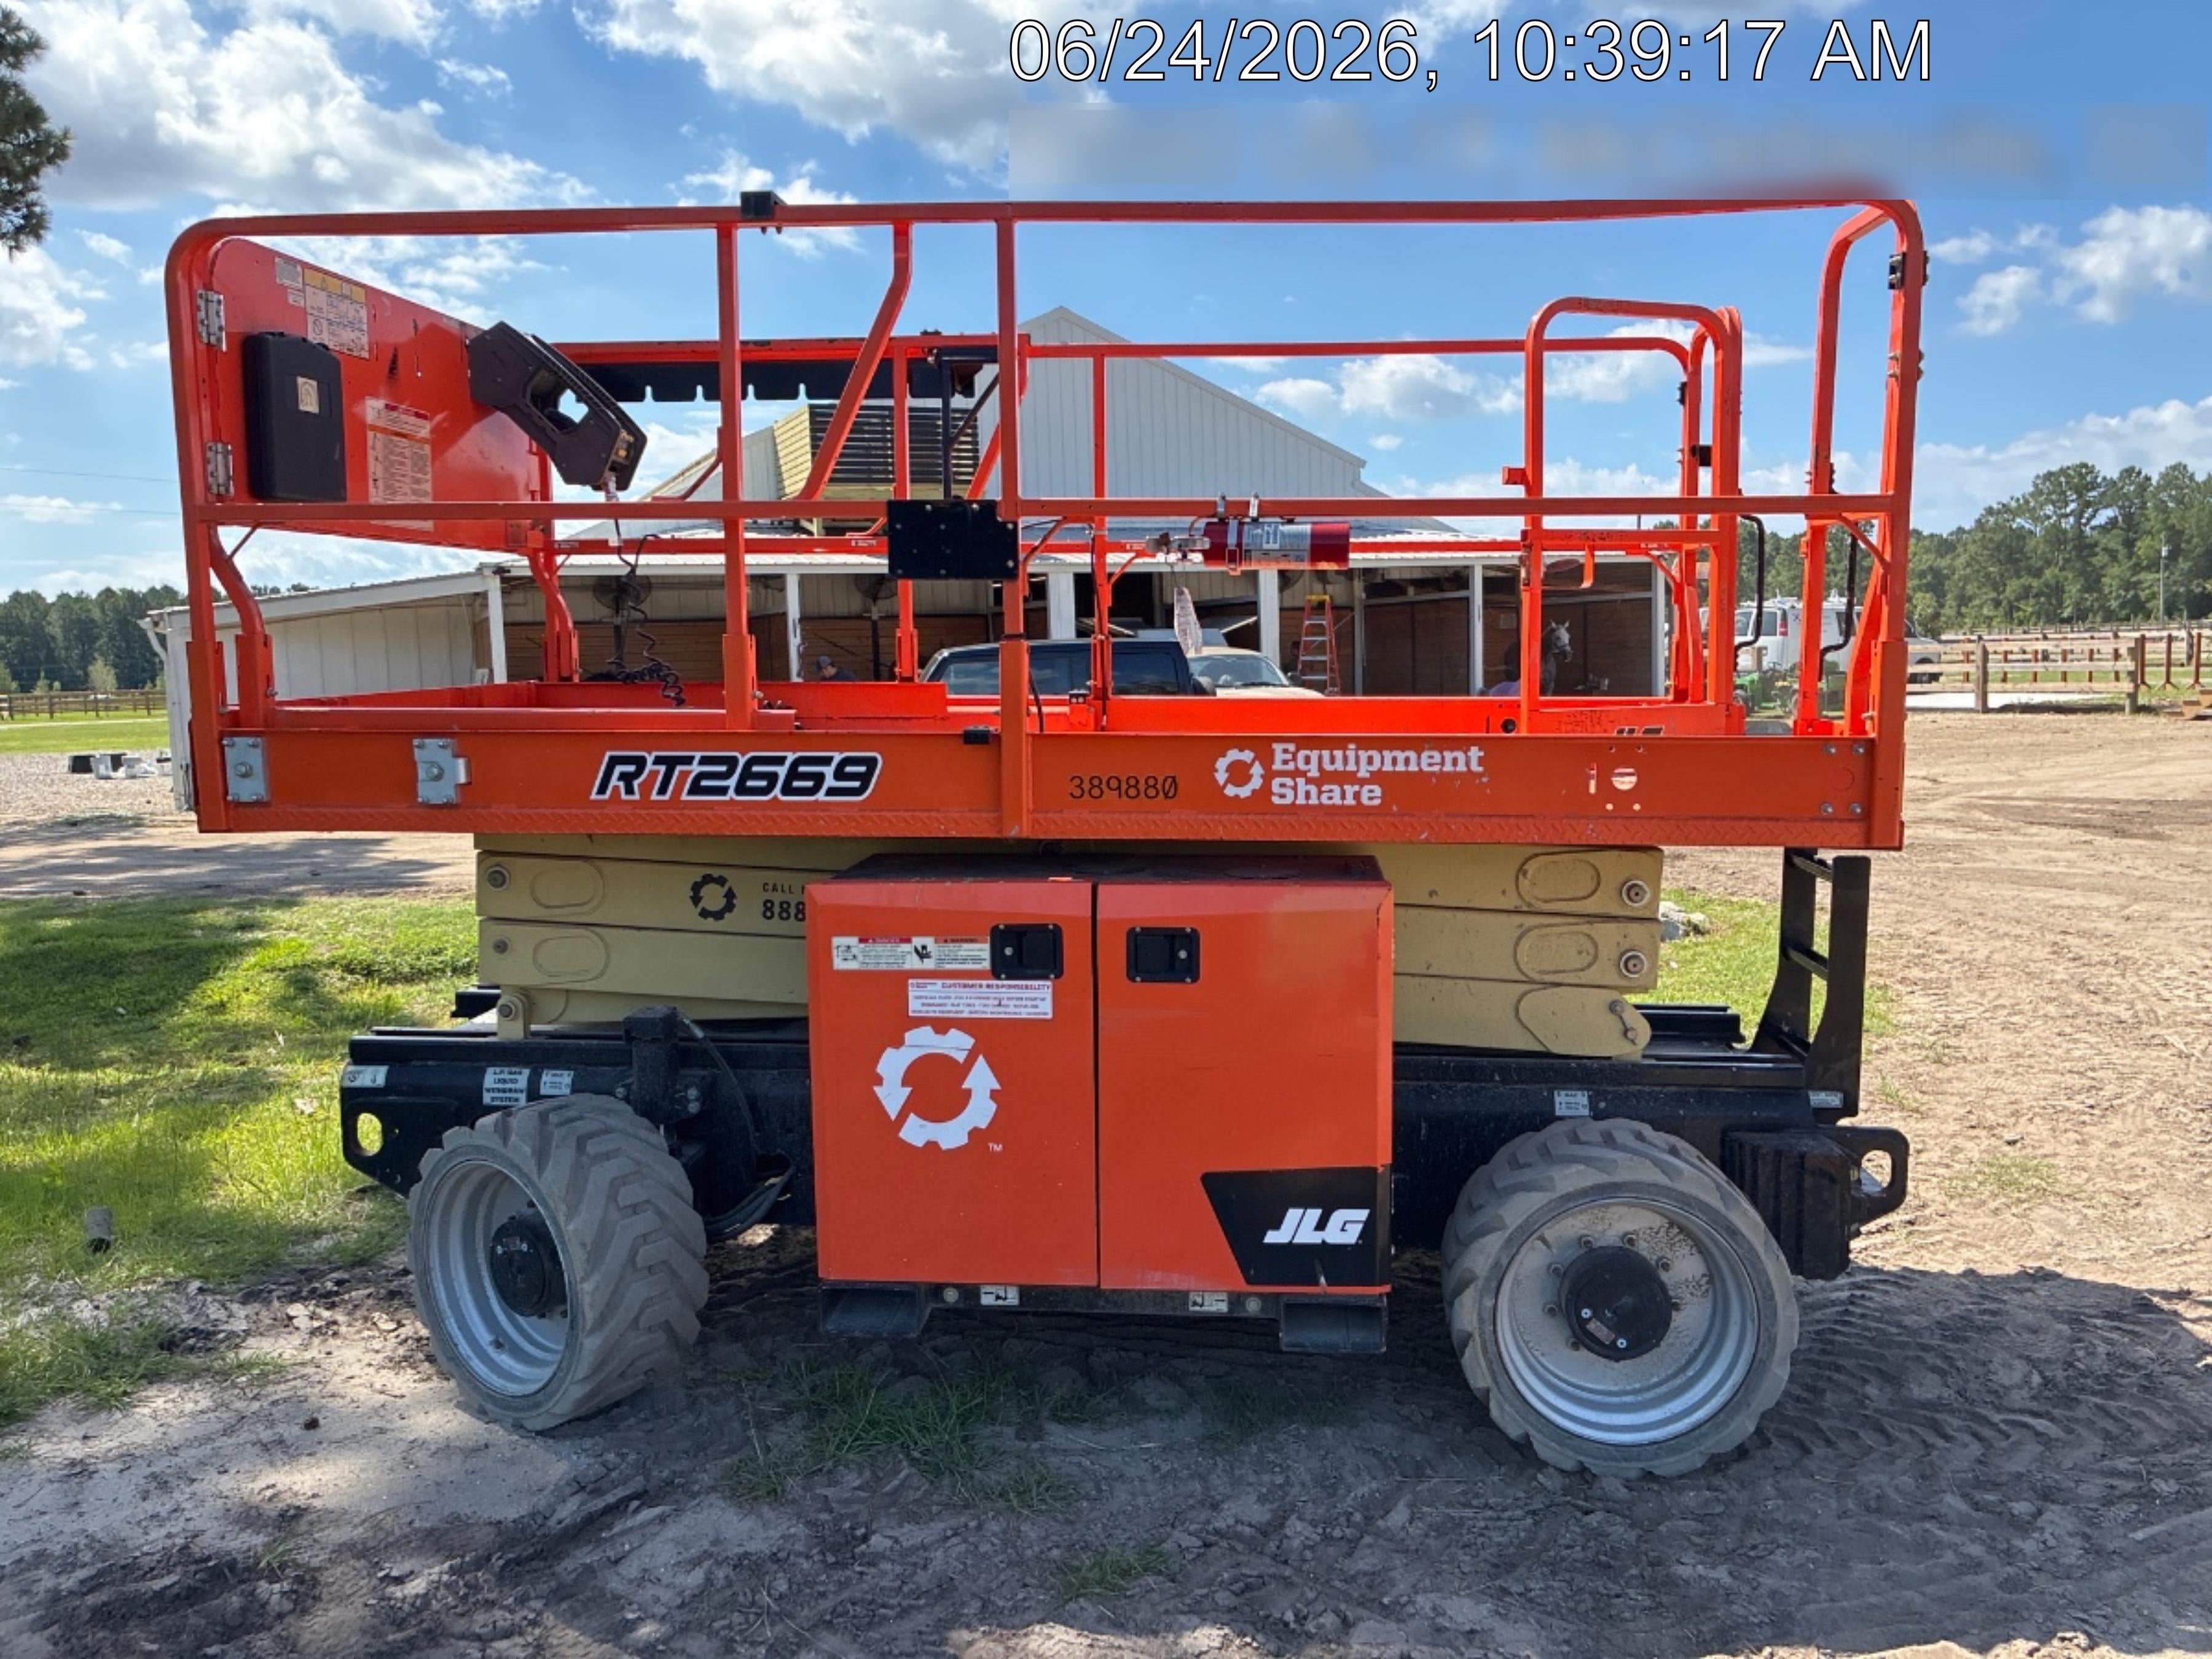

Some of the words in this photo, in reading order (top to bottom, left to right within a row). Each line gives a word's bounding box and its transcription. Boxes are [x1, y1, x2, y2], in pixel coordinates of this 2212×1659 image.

[590, 751, 883, 801] RT2669
[1271, 742, 1484, 778] Equipment
[1069, 775, 1179, 799] 389880
[1271, 777, 1382, 806] Share
[762, 882, 795, 895] CALL
[1263, 1208, 1371, 1245] JLG
